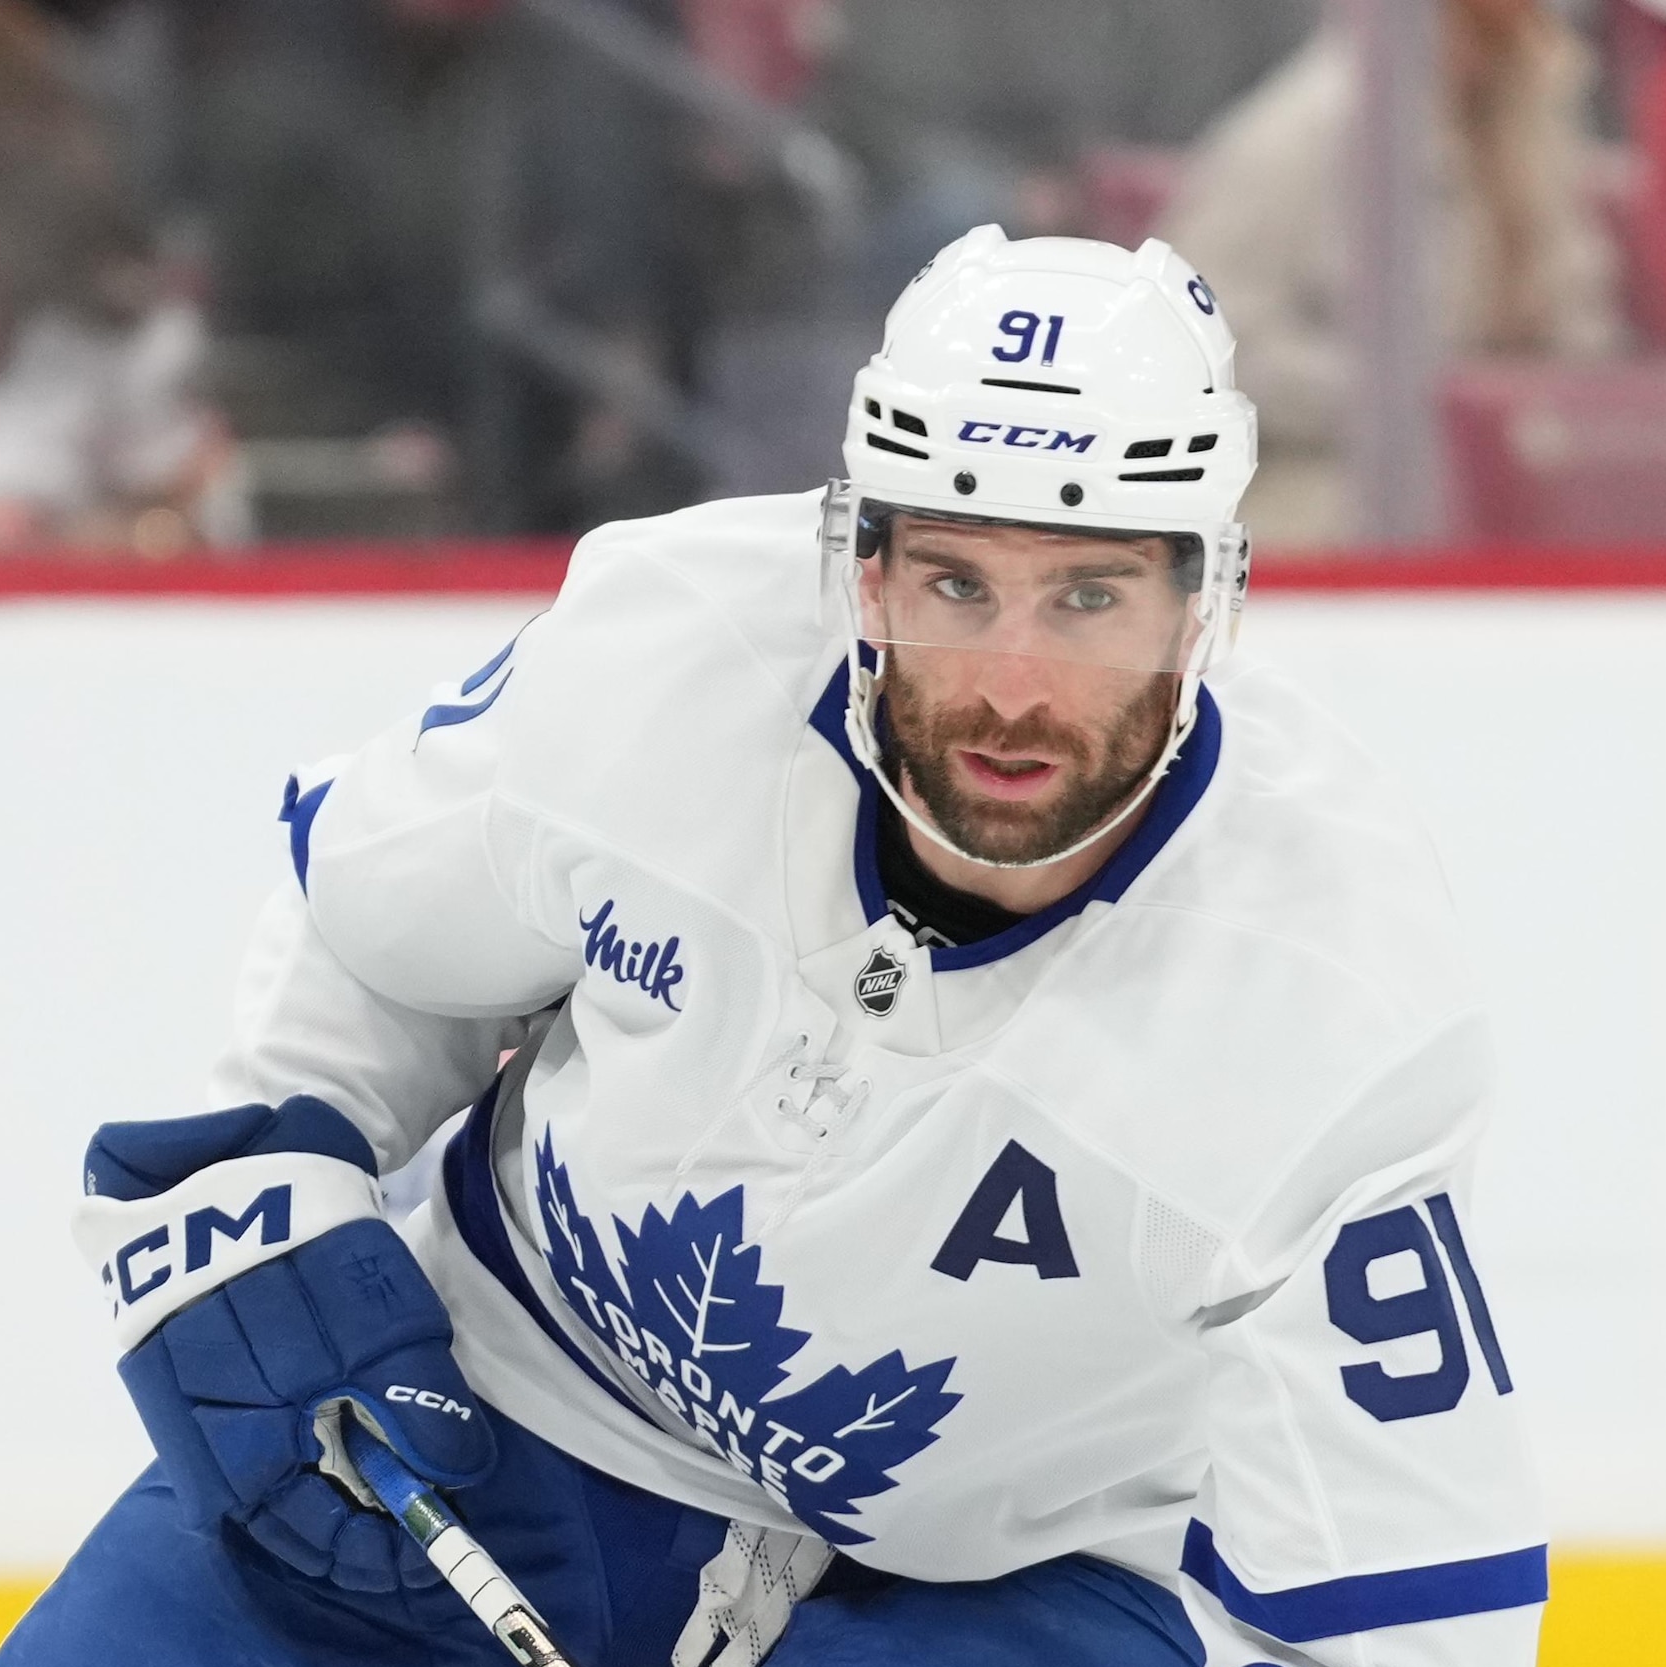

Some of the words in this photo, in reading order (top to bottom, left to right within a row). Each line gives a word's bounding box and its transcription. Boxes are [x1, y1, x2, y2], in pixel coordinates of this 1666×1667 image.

[992, 310, 1064, 367] 91
[957, 420, 1098, 453] CCM
[579, 899, 684, 1012] Milk
[860, 971, 897, 995] NHL
[102, 1183, 292, 1320] CM
[930, 1138, 1081, 1282] A
[1324, 1192, 1514, 1423] 91
[385, 1385, 472, 1421] CCM
[570, 1275, 846, 1483] TORONTO
